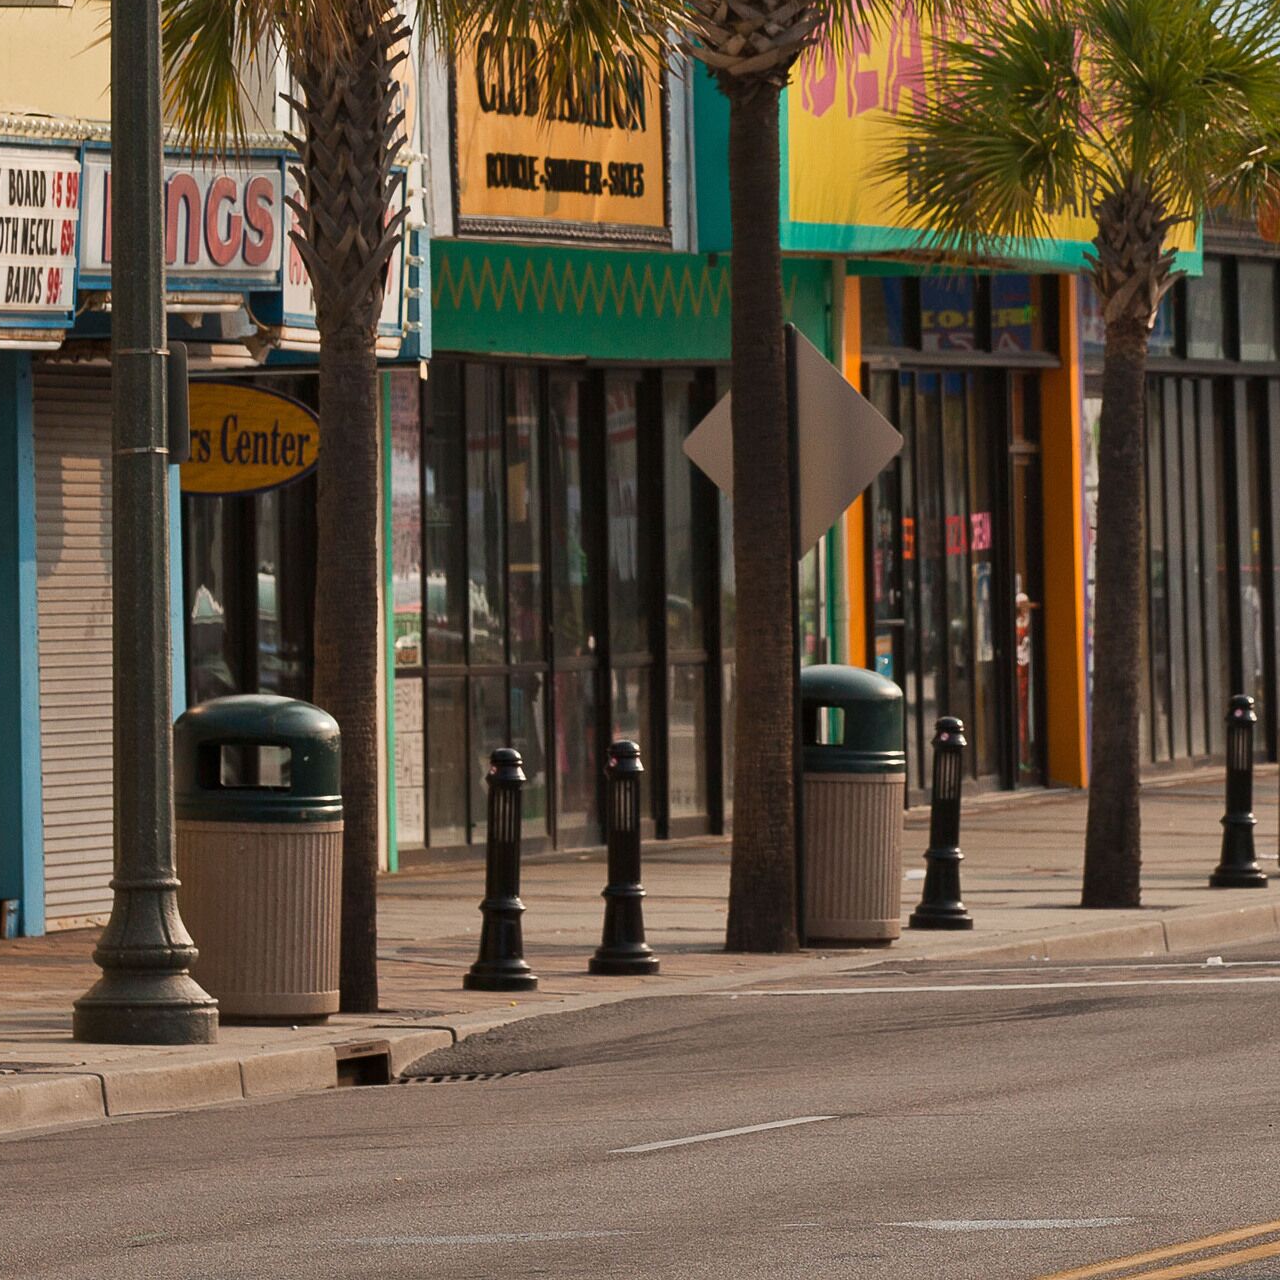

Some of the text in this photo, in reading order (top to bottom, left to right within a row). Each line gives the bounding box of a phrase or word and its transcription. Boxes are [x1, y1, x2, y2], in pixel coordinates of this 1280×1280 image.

[8, 168, 47, 208] BOARD
[102, 169, 275, 267] NGS
[4, 265, 44, 304] BANDS
[187, 412, 312, 467] rs Center
